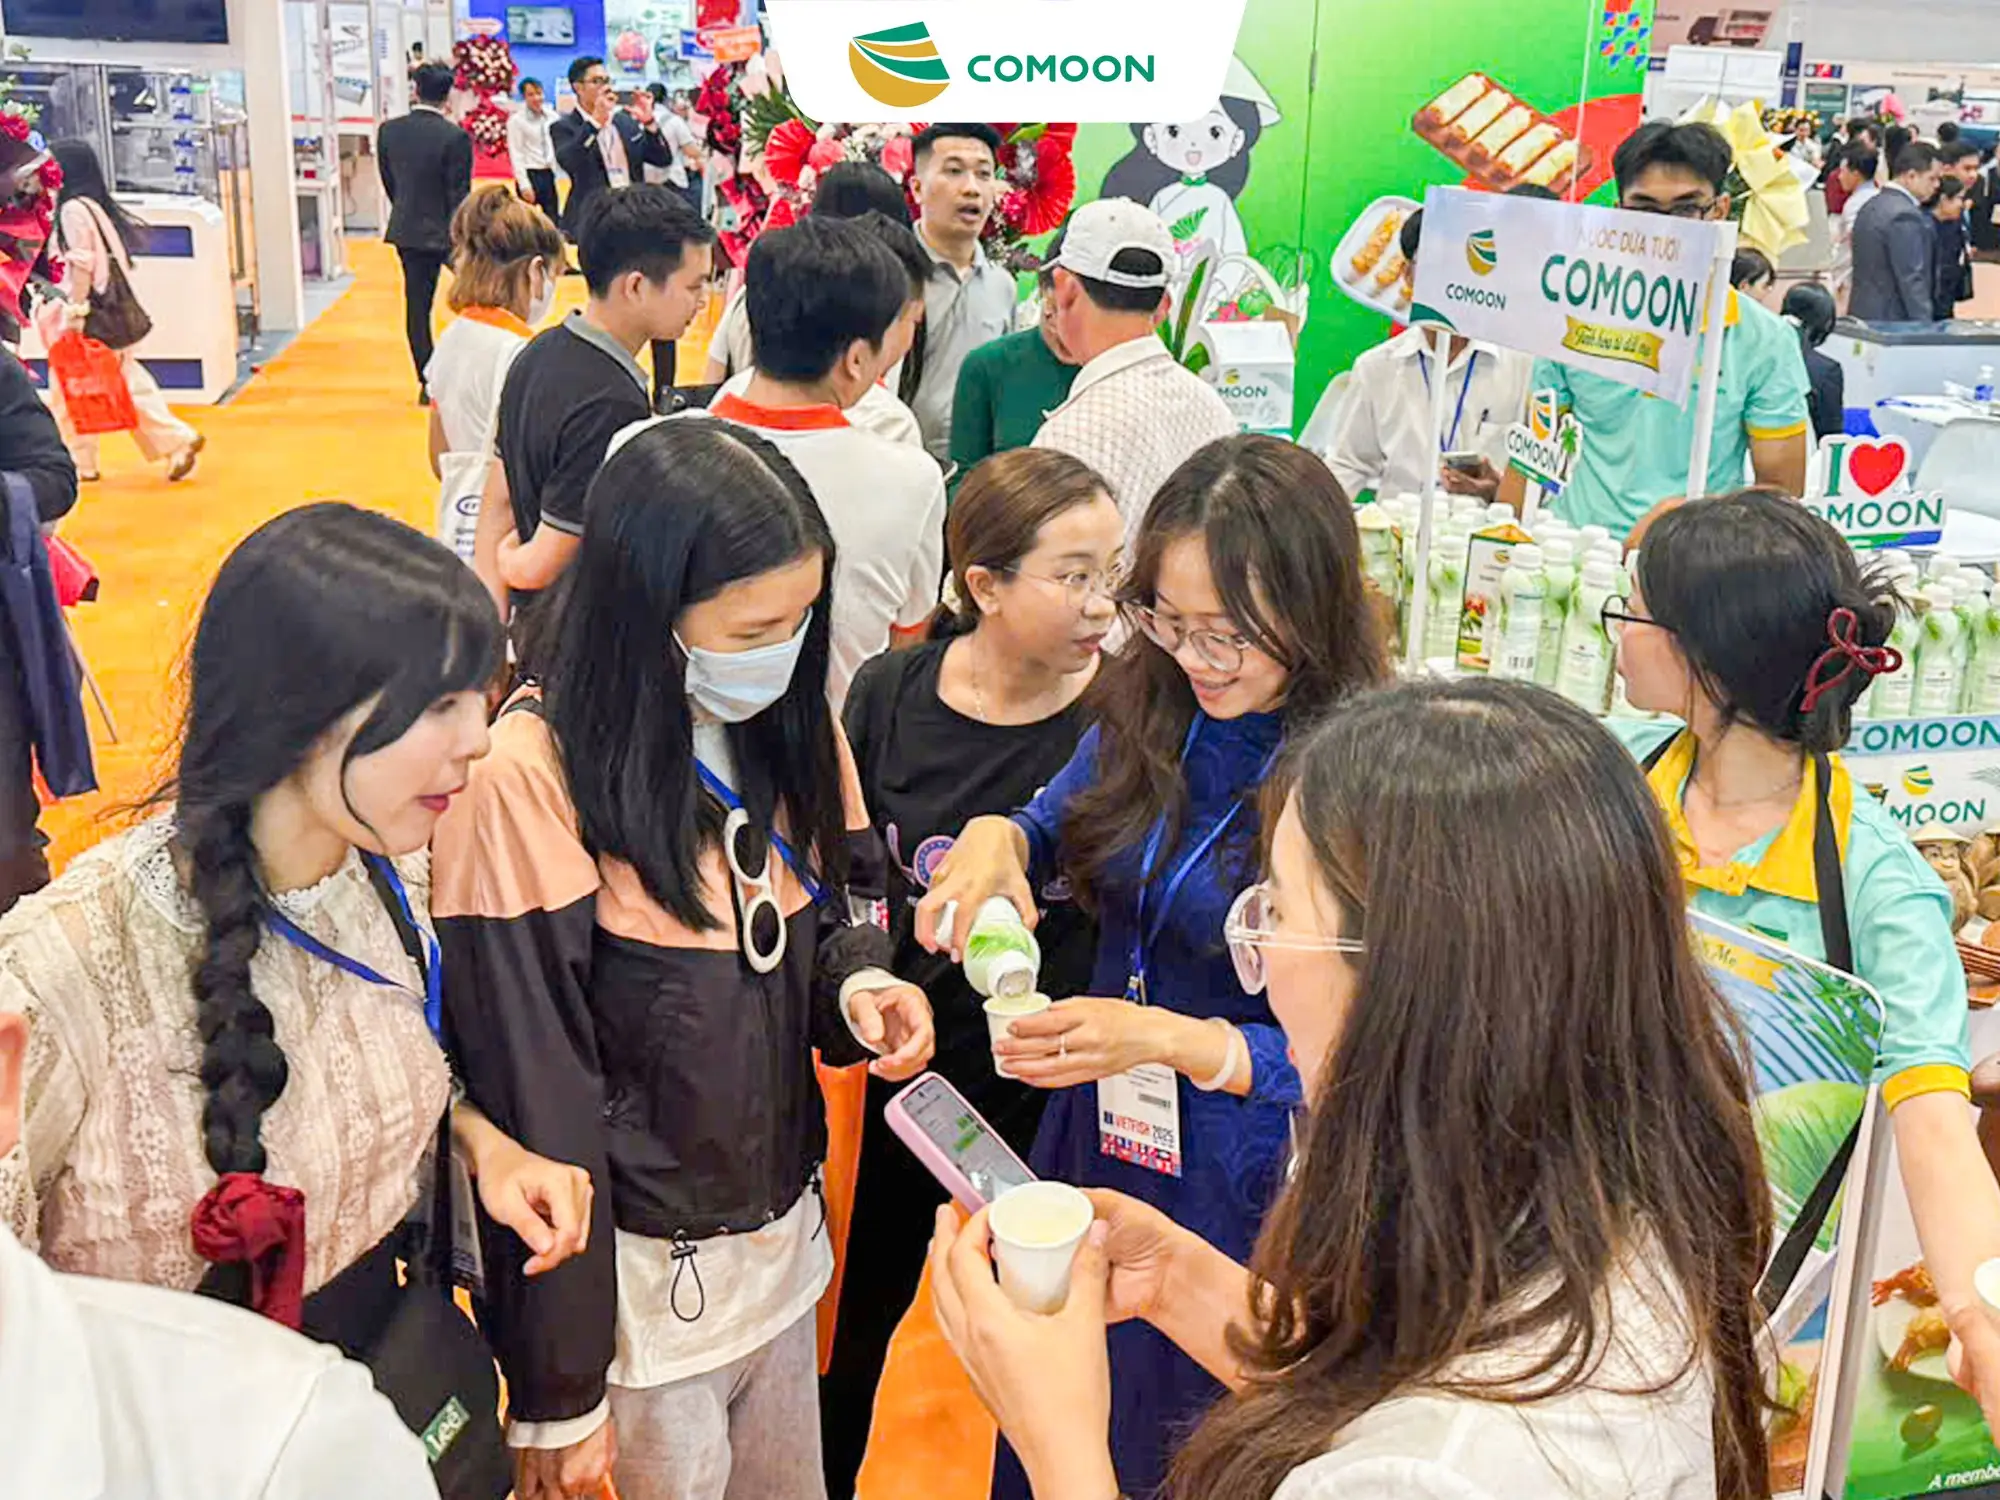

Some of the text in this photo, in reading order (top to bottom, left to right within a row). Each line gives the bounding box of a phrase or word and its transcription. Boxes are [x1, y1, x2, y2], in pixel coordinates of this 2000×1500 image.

[1446, 283, 1506, 311] COMOON
[1541, 254, 1698, 337] COMOON
[1218, 386, 1268, 398] MOON
[1508, 430, 1560, 475] COMOON
[1823, 443, 1847, 497] I
[1808, 498, 1943, 529] MOON
[1889, 799, 1985, 827] MOON
[427, 1404, 461, 1453] Lee
[1926, 1473, 1943, 1491] A
